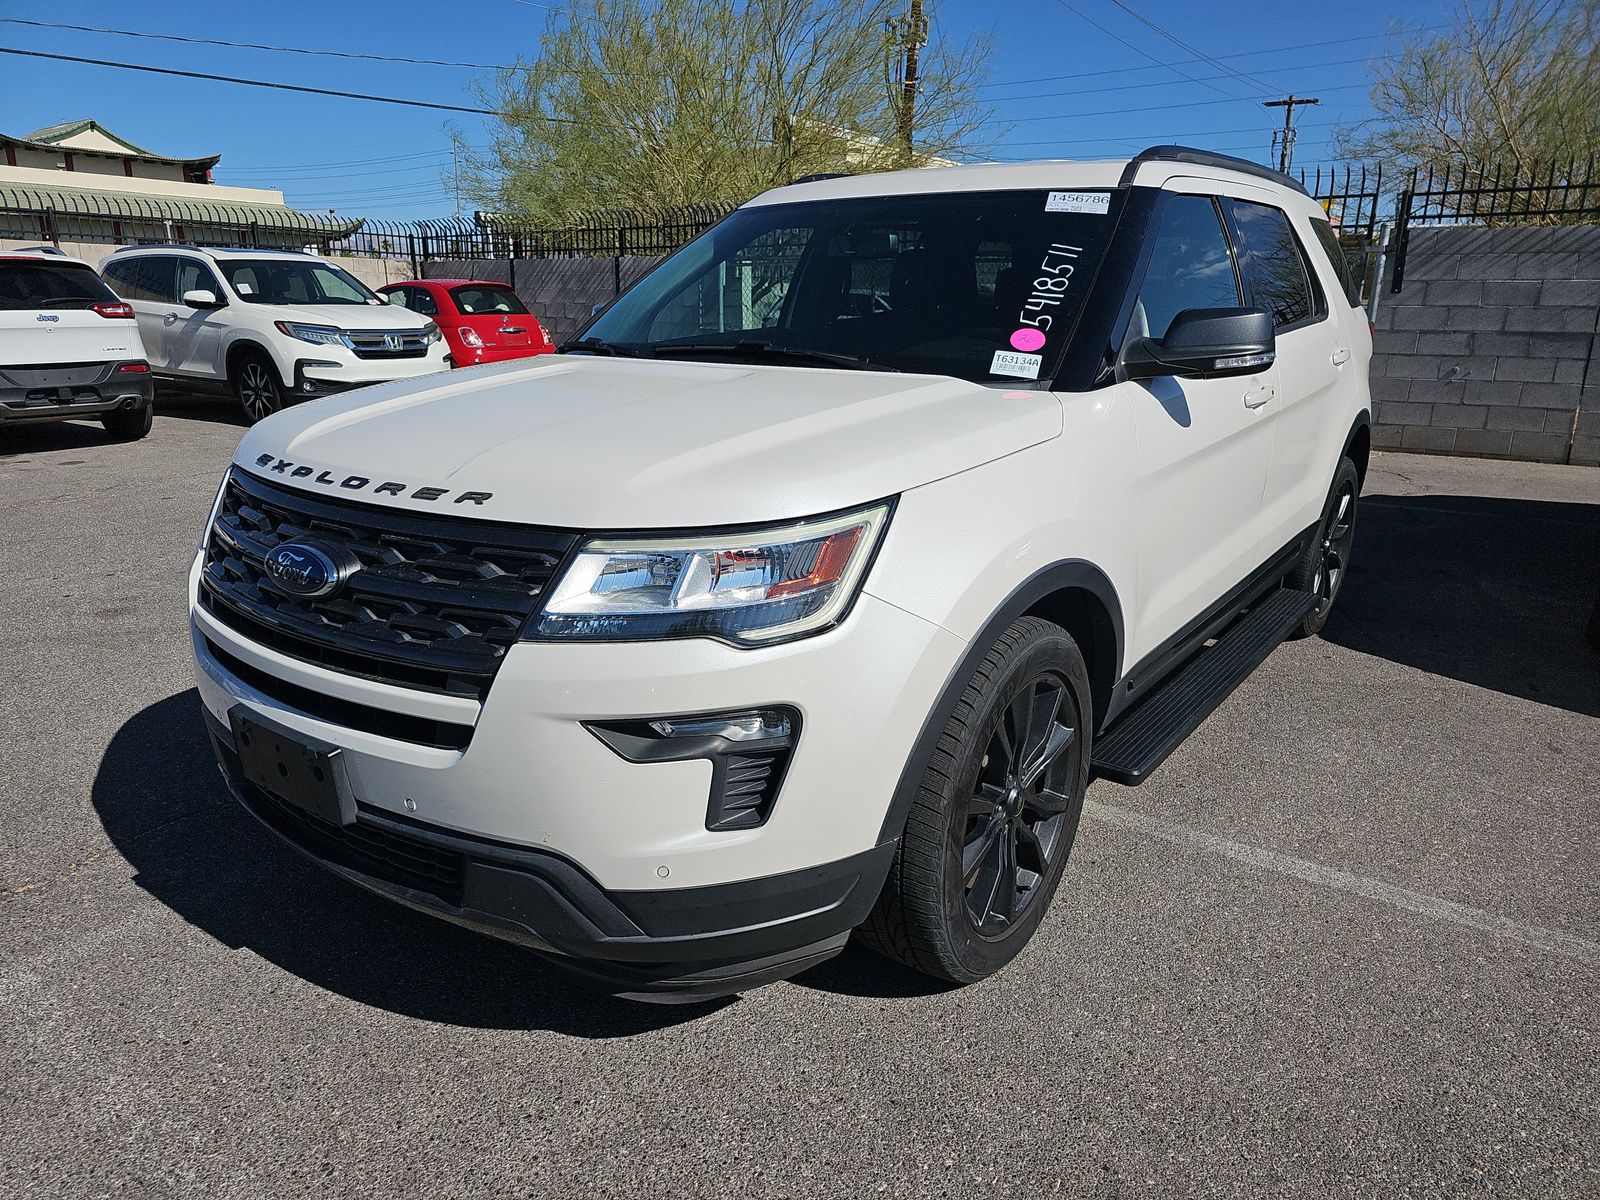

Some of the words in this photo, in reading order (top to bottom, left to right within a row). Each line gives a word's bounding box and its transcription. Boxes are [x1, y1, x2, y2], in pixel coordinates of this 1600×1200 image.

[1052, 194, 1110, 204] 1456786
[1019, 243, 1083, 331] 5418511
[36, 313, 60, 323] Jeep
[996, 354, 1039, 367] T63134A
[254, 453, 494, 506] EXPLORER
[269, 551, 313, 585] Ford
